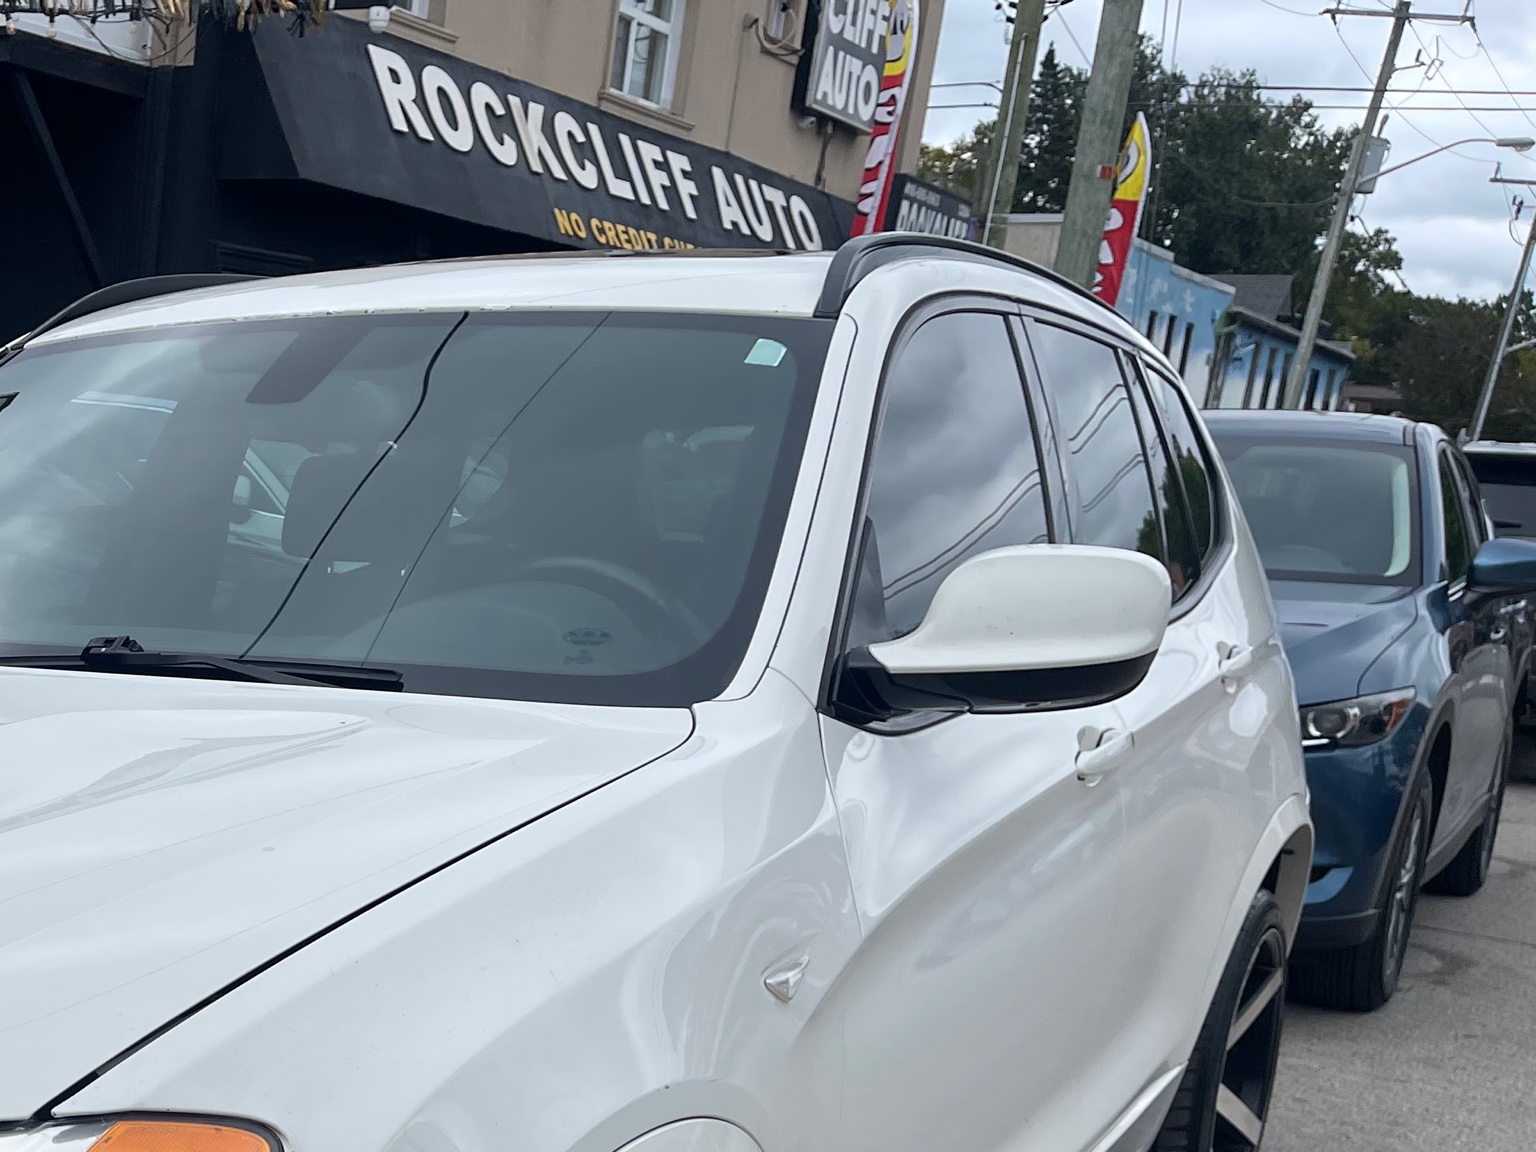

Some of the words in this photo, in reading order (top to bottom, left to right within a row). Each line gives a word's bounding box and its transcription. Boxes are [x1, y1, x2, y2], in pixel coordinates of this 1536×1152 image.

[829, 0, 891, 54] CLIFF
[816, 45, 879, 122] AUTO
[367, 43, 699, 220] ROCKCLIFF
[710, 165, 823, 250] AUTO
[553, 207, 587, 239] NO
[590, 217, 657, 250] CREDIT
